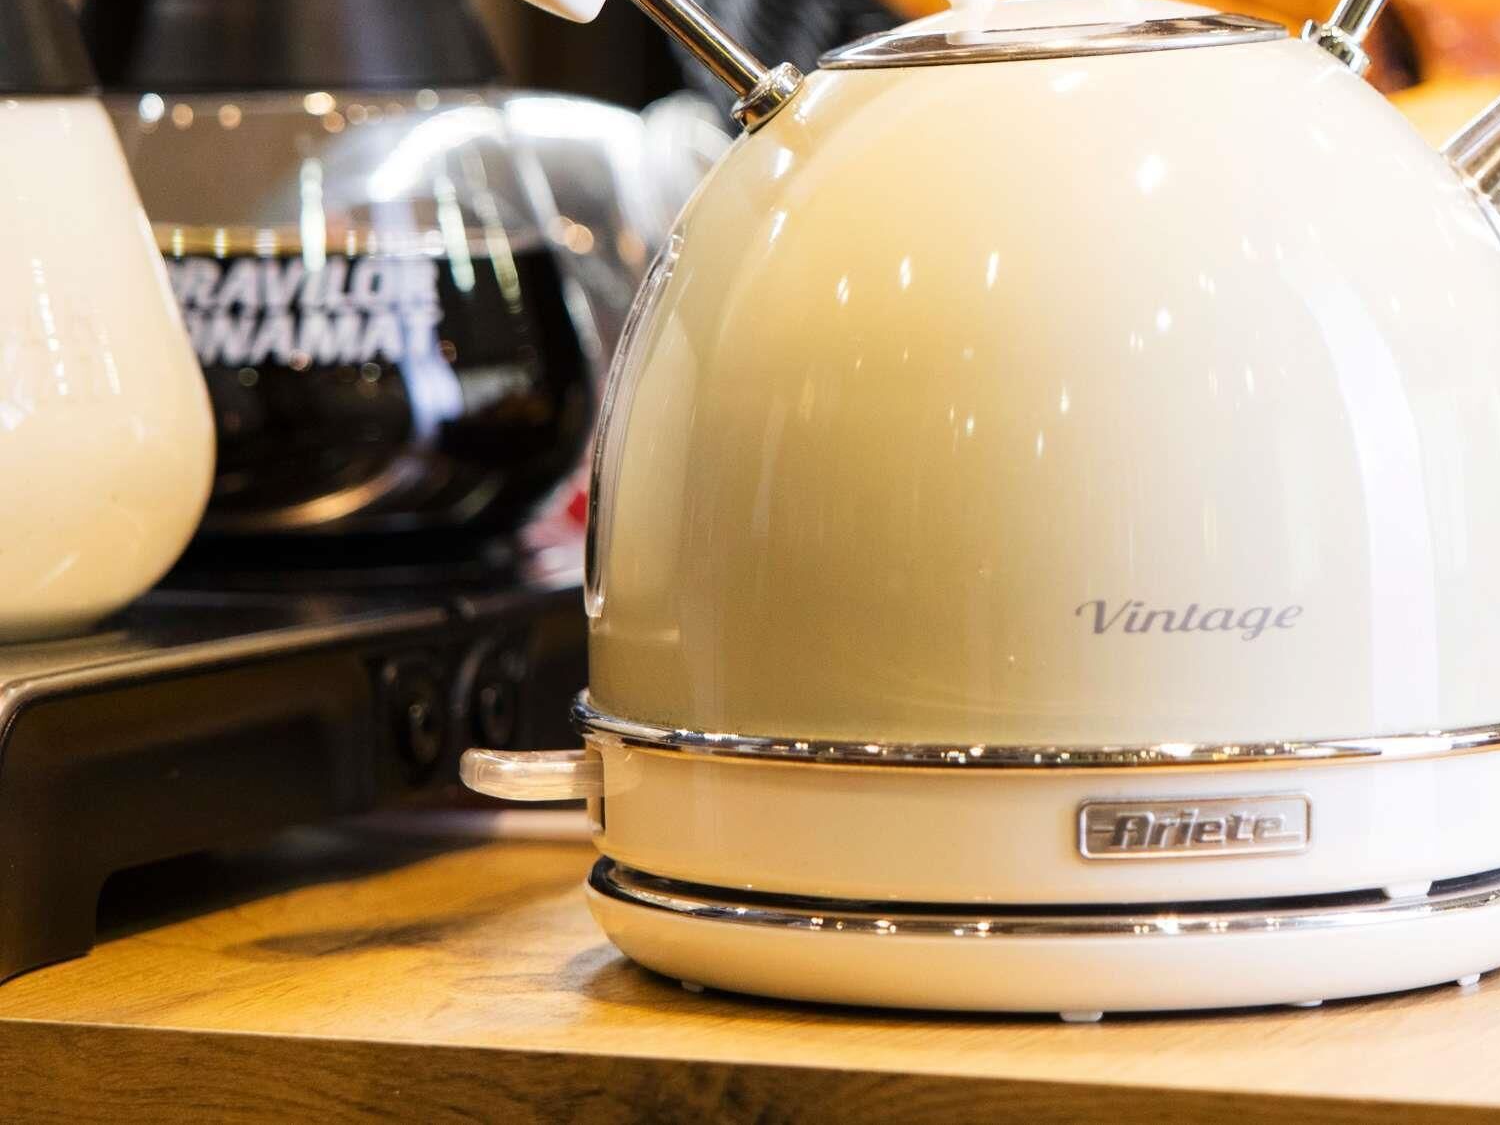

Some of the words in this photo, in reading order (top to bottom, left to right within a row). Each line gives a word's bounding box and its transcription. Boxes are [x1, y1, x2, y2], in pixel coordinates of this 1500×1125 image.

[167, 255, 438, 308] RAVILOR
[182, 308, 442, 365] NAMAT
[1075, 599, 1303, 641] Vintage
[1092, 807, 1301, 849] Ariete
